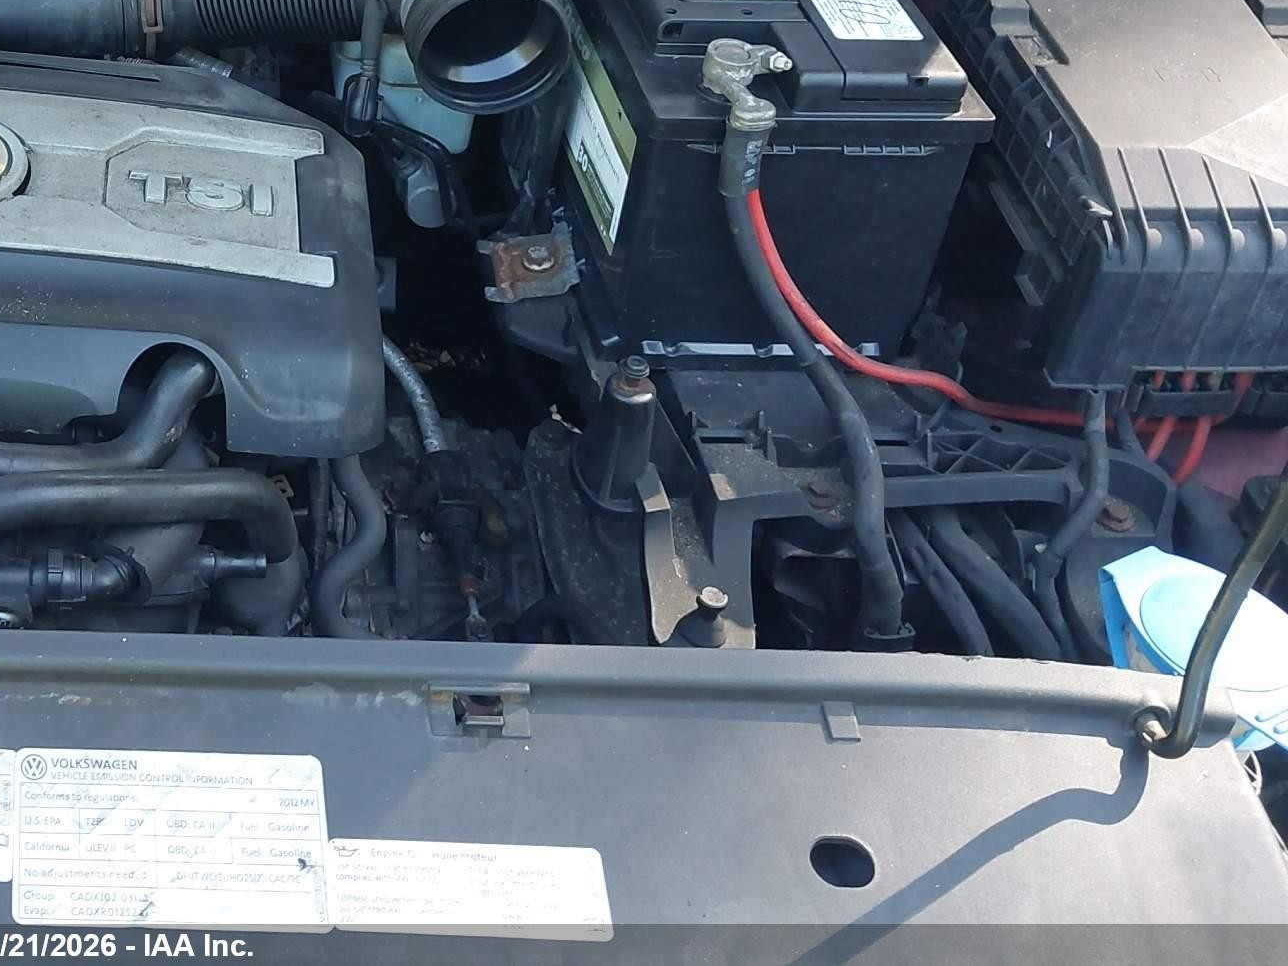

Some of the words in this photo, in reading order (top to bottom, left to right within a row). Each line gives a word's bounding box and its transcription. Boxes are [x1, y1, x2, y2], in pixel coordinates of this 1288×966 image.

[127, 168, 275, 218] TSI
[50, 757, 138, 771] VOLKSWAGEN
[24, 790, 70, 801] Conforms
[269, 848, 313, 859] Gasoline
